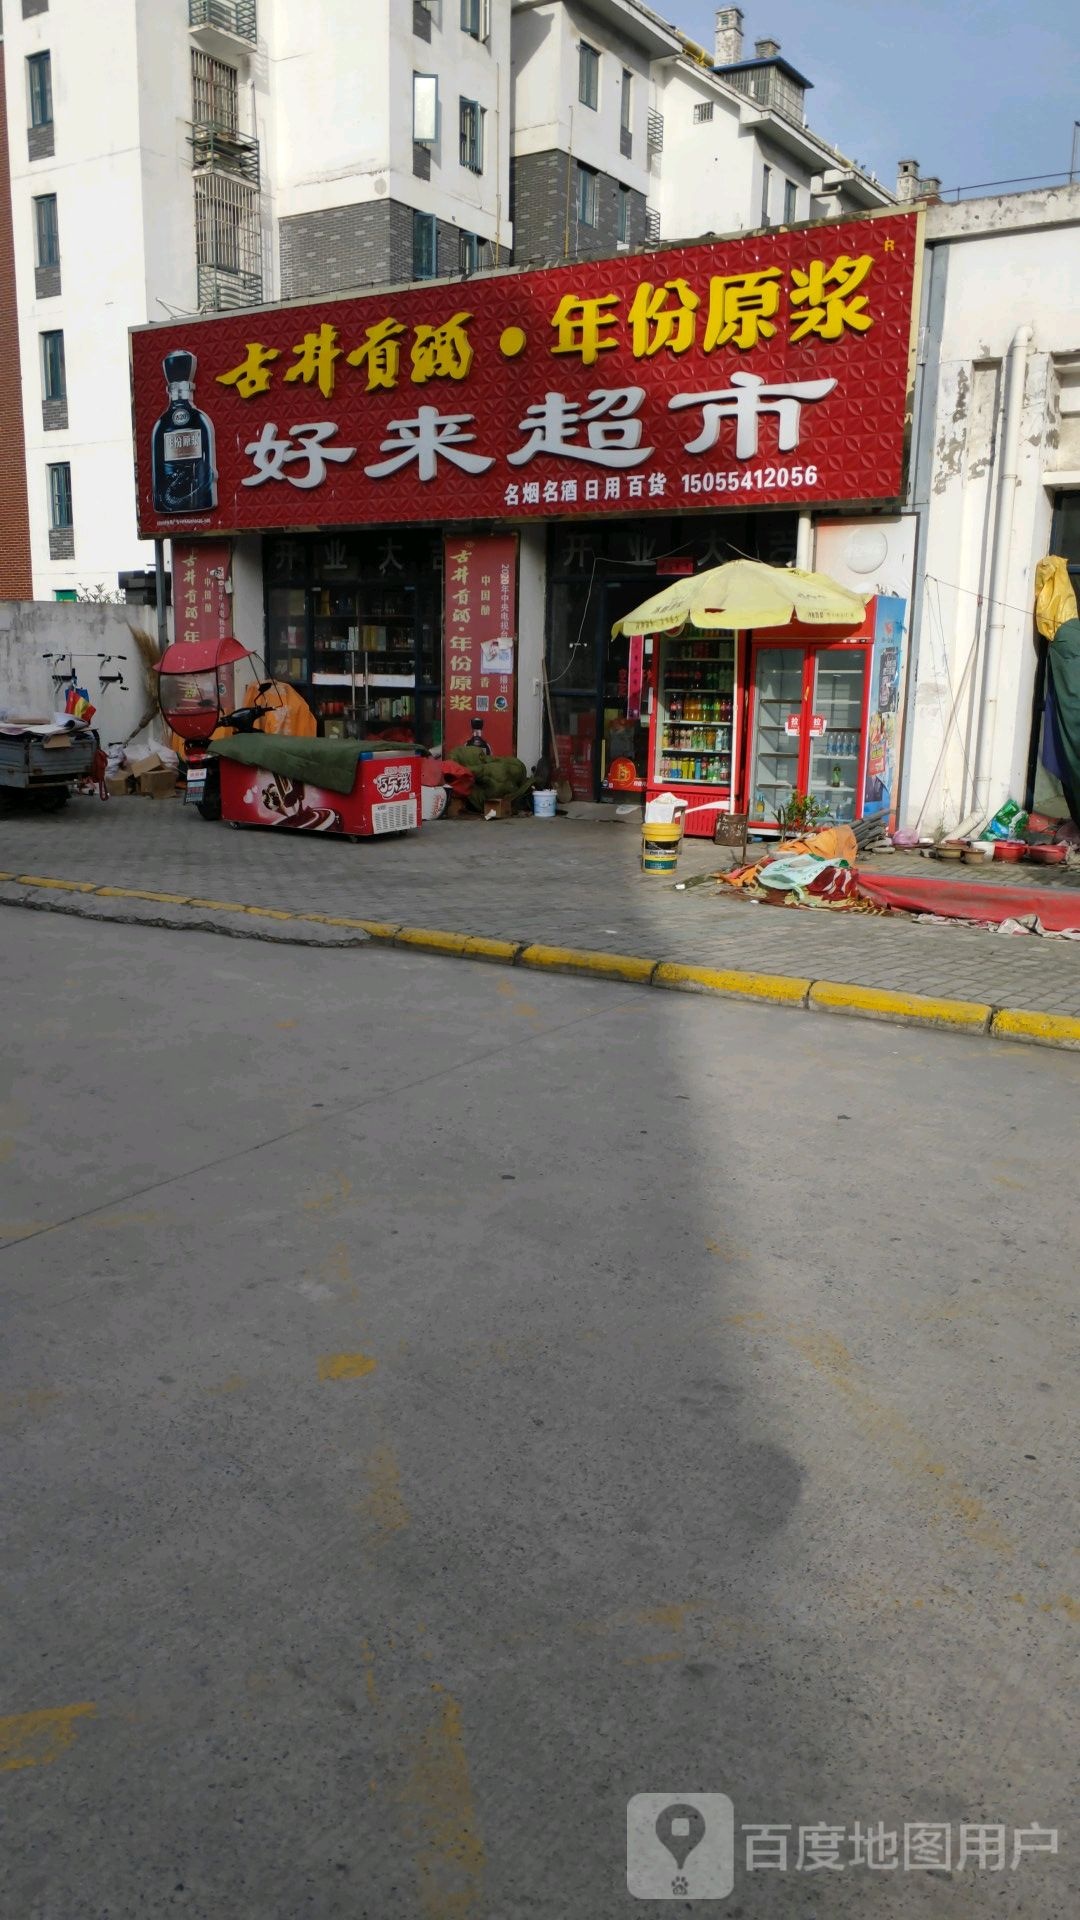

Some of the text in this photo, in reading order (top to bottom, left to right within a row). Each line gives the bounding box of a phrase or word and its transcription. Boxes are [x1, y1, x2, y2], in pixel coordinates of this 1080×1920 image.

[884, 239, 896, 252] R
[240, 371, 838, 489] 好来超市
[681, 465, 818, 494] 15055412056
